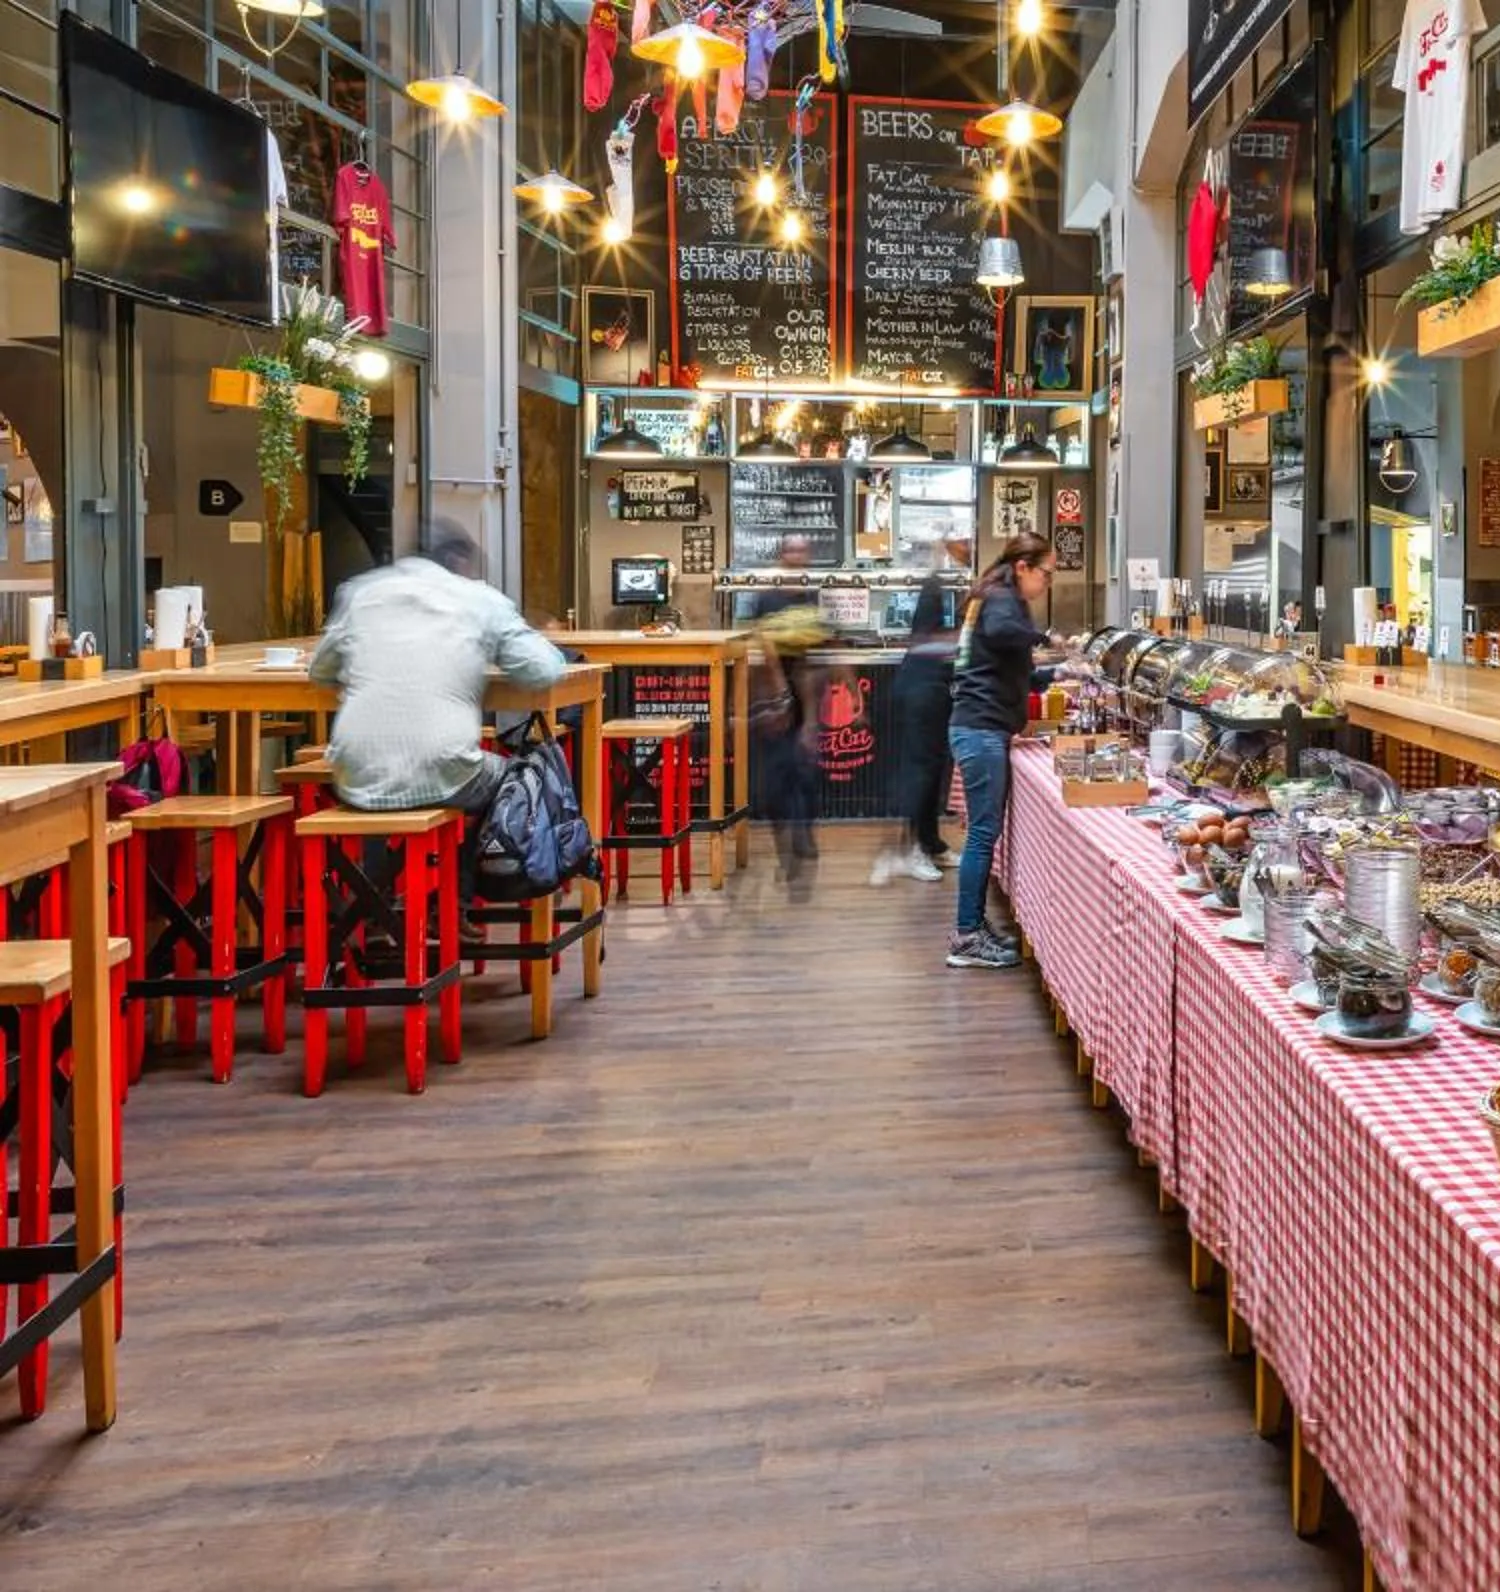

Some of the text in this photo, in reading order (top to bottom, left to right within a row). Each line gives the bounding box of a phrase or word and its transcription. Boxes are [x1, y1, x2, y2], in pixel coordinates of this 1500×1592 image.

[862, 109, 933, 139] BEERS
[695, 264, 740, 281] TYPES
[743, 266, 763, 281] OF
[787, 309, 825, 324] OUR
[866, 317, 918, 333] MOTHER
[211, 489, 225, 506] B
